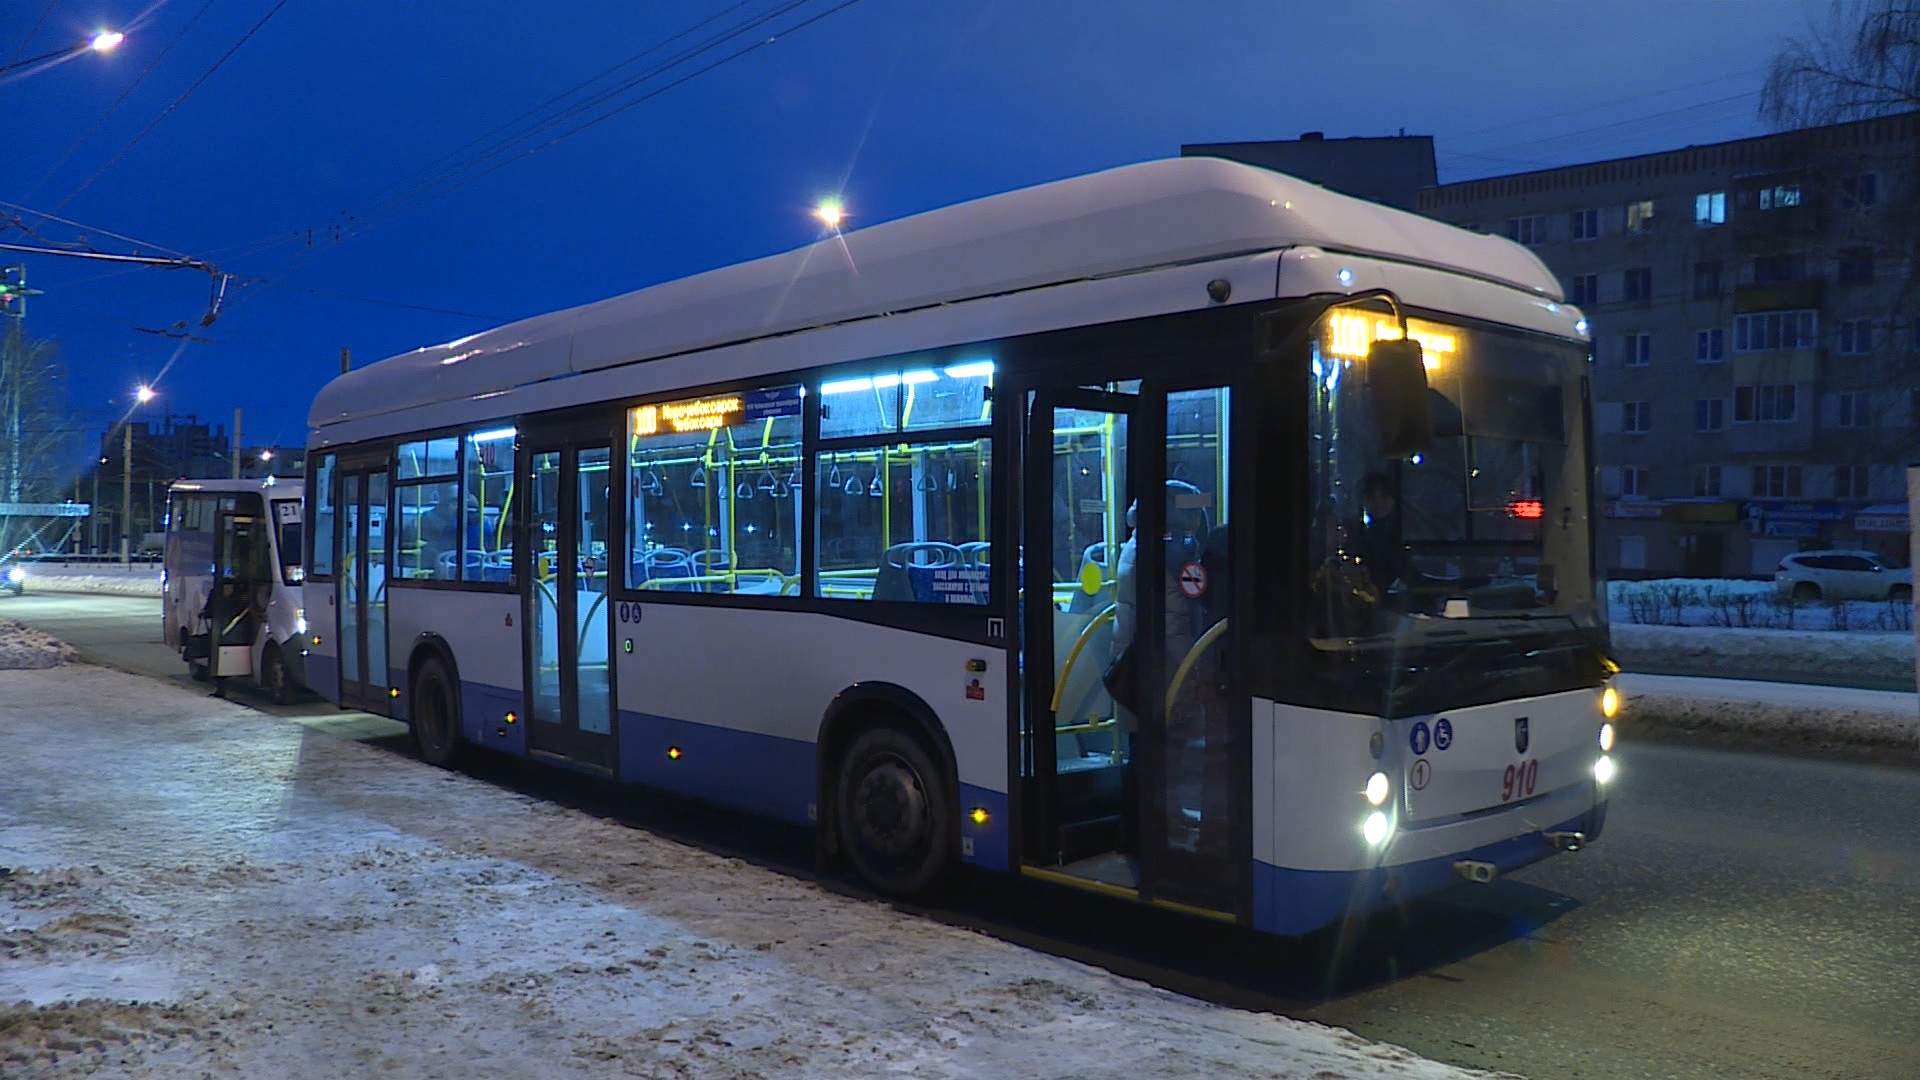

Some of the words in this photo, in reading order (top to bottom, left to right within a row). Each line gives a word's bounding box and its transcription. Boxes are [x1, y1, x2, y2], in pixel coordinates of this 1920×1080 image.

[1330, 314, 1368, 357] 100
[636, 406, 657, 434] 100
[281, 505, 297, 517] 21
[1501, 758, 1538, 802] 910
